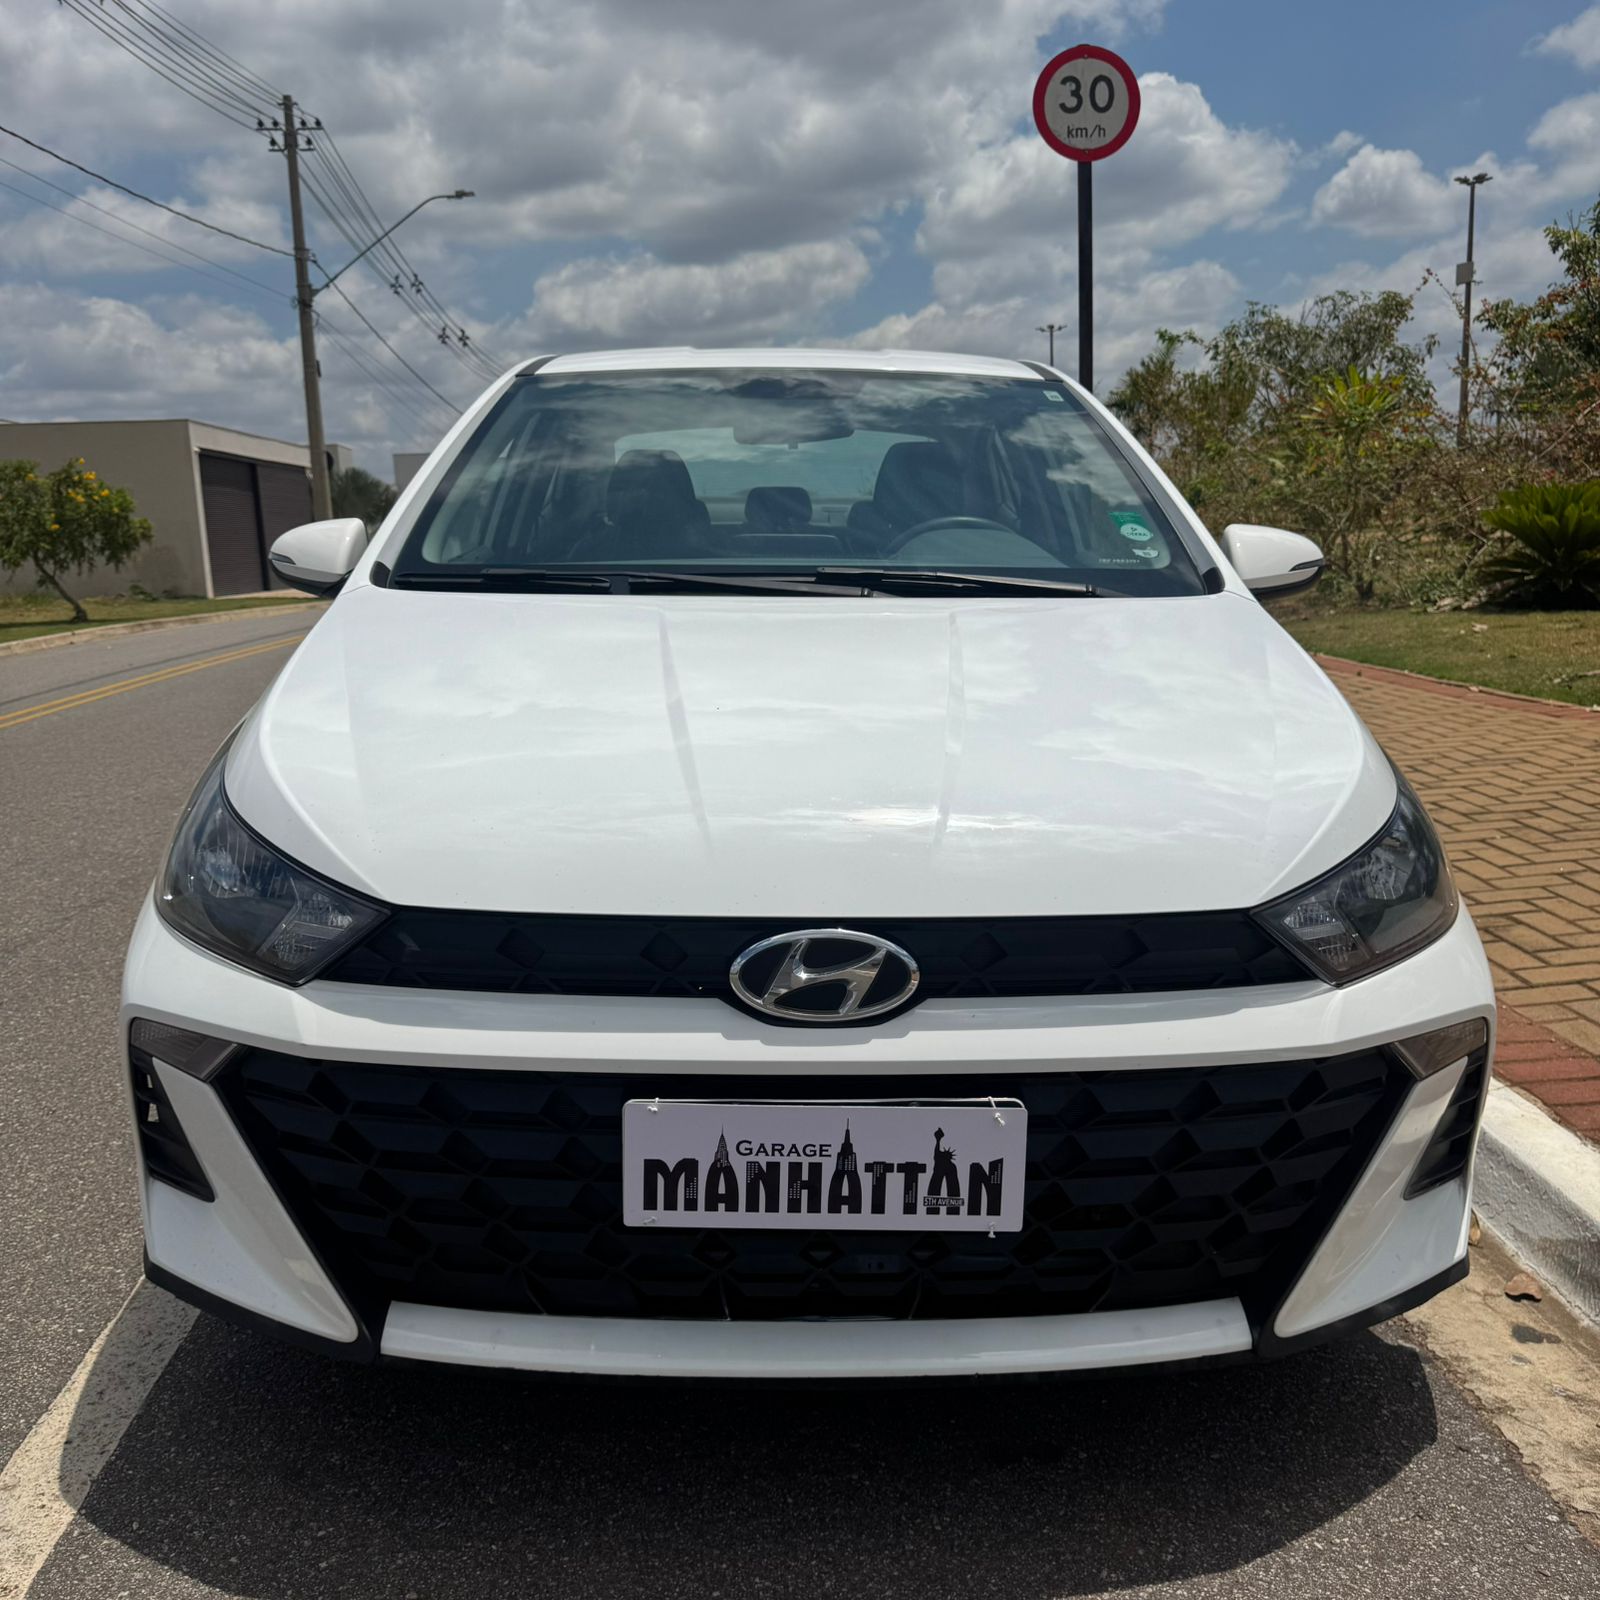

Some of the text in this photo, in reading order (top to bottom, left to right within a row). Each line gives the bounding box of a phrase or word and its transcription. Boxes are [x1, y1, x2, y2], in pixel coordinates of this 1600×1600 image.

[1059, 75, 1115, 114] 30
[1067, 124, 1106, 138] km/h
[735, 1140, 832, 1158] GARAGE
[643, 1154, 1004, 1217] MANHATTAN
[938, 1198, 963, 1206] AVENUE
